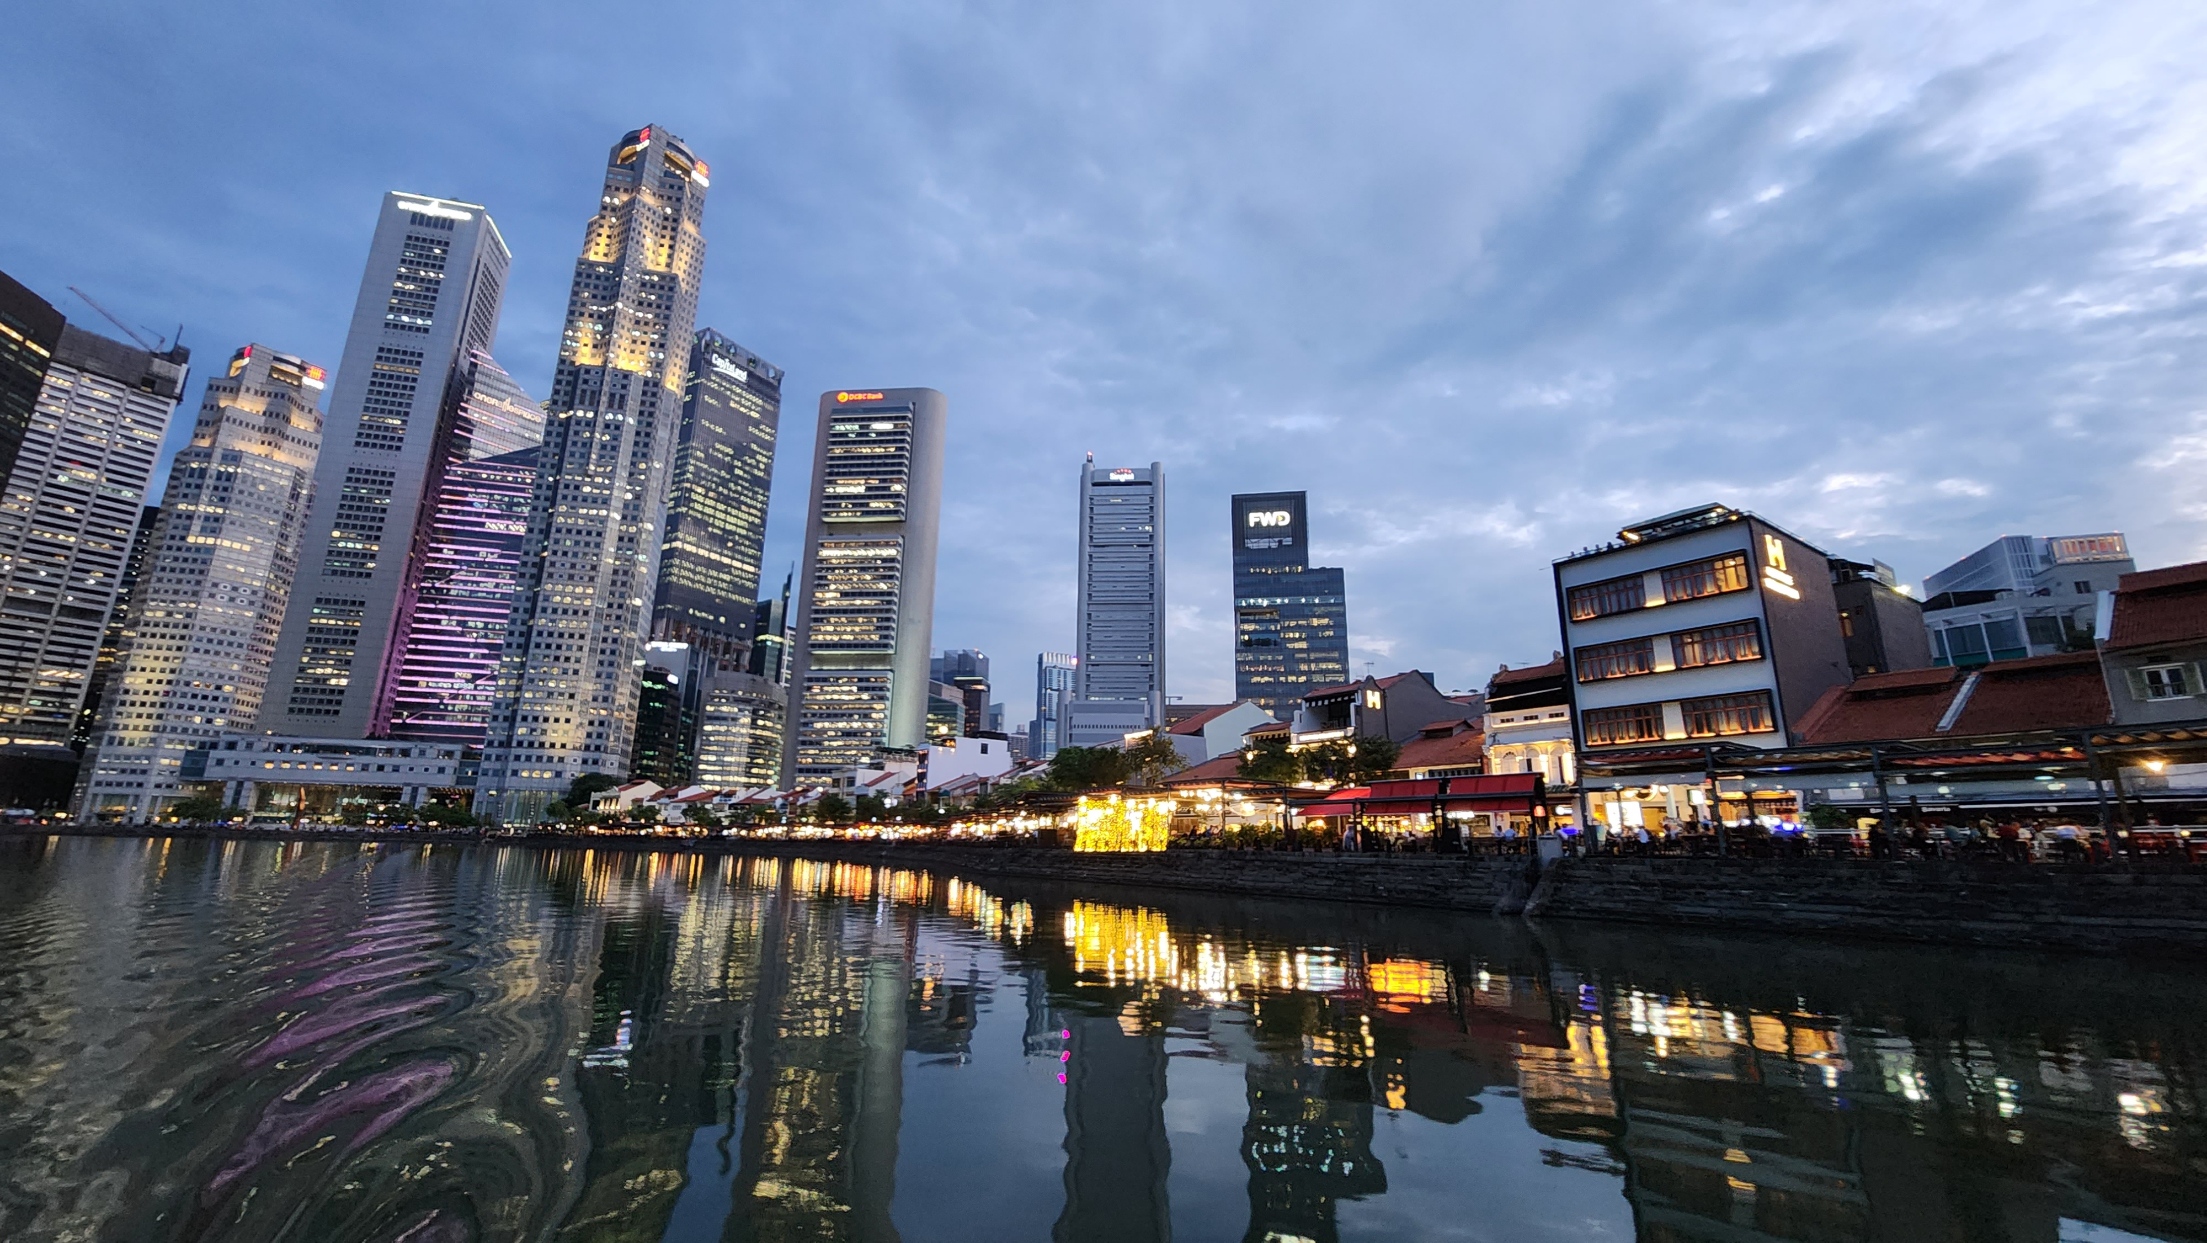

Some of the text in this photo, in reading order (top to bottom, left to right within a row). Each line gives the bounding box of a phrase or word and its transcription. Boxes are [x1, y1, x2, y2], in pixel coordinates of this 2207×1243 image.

[1248, 511, 1291, 528] FWD
[1763, 534, 1787, 571] H
[1366, 690, 1381, 710] H
